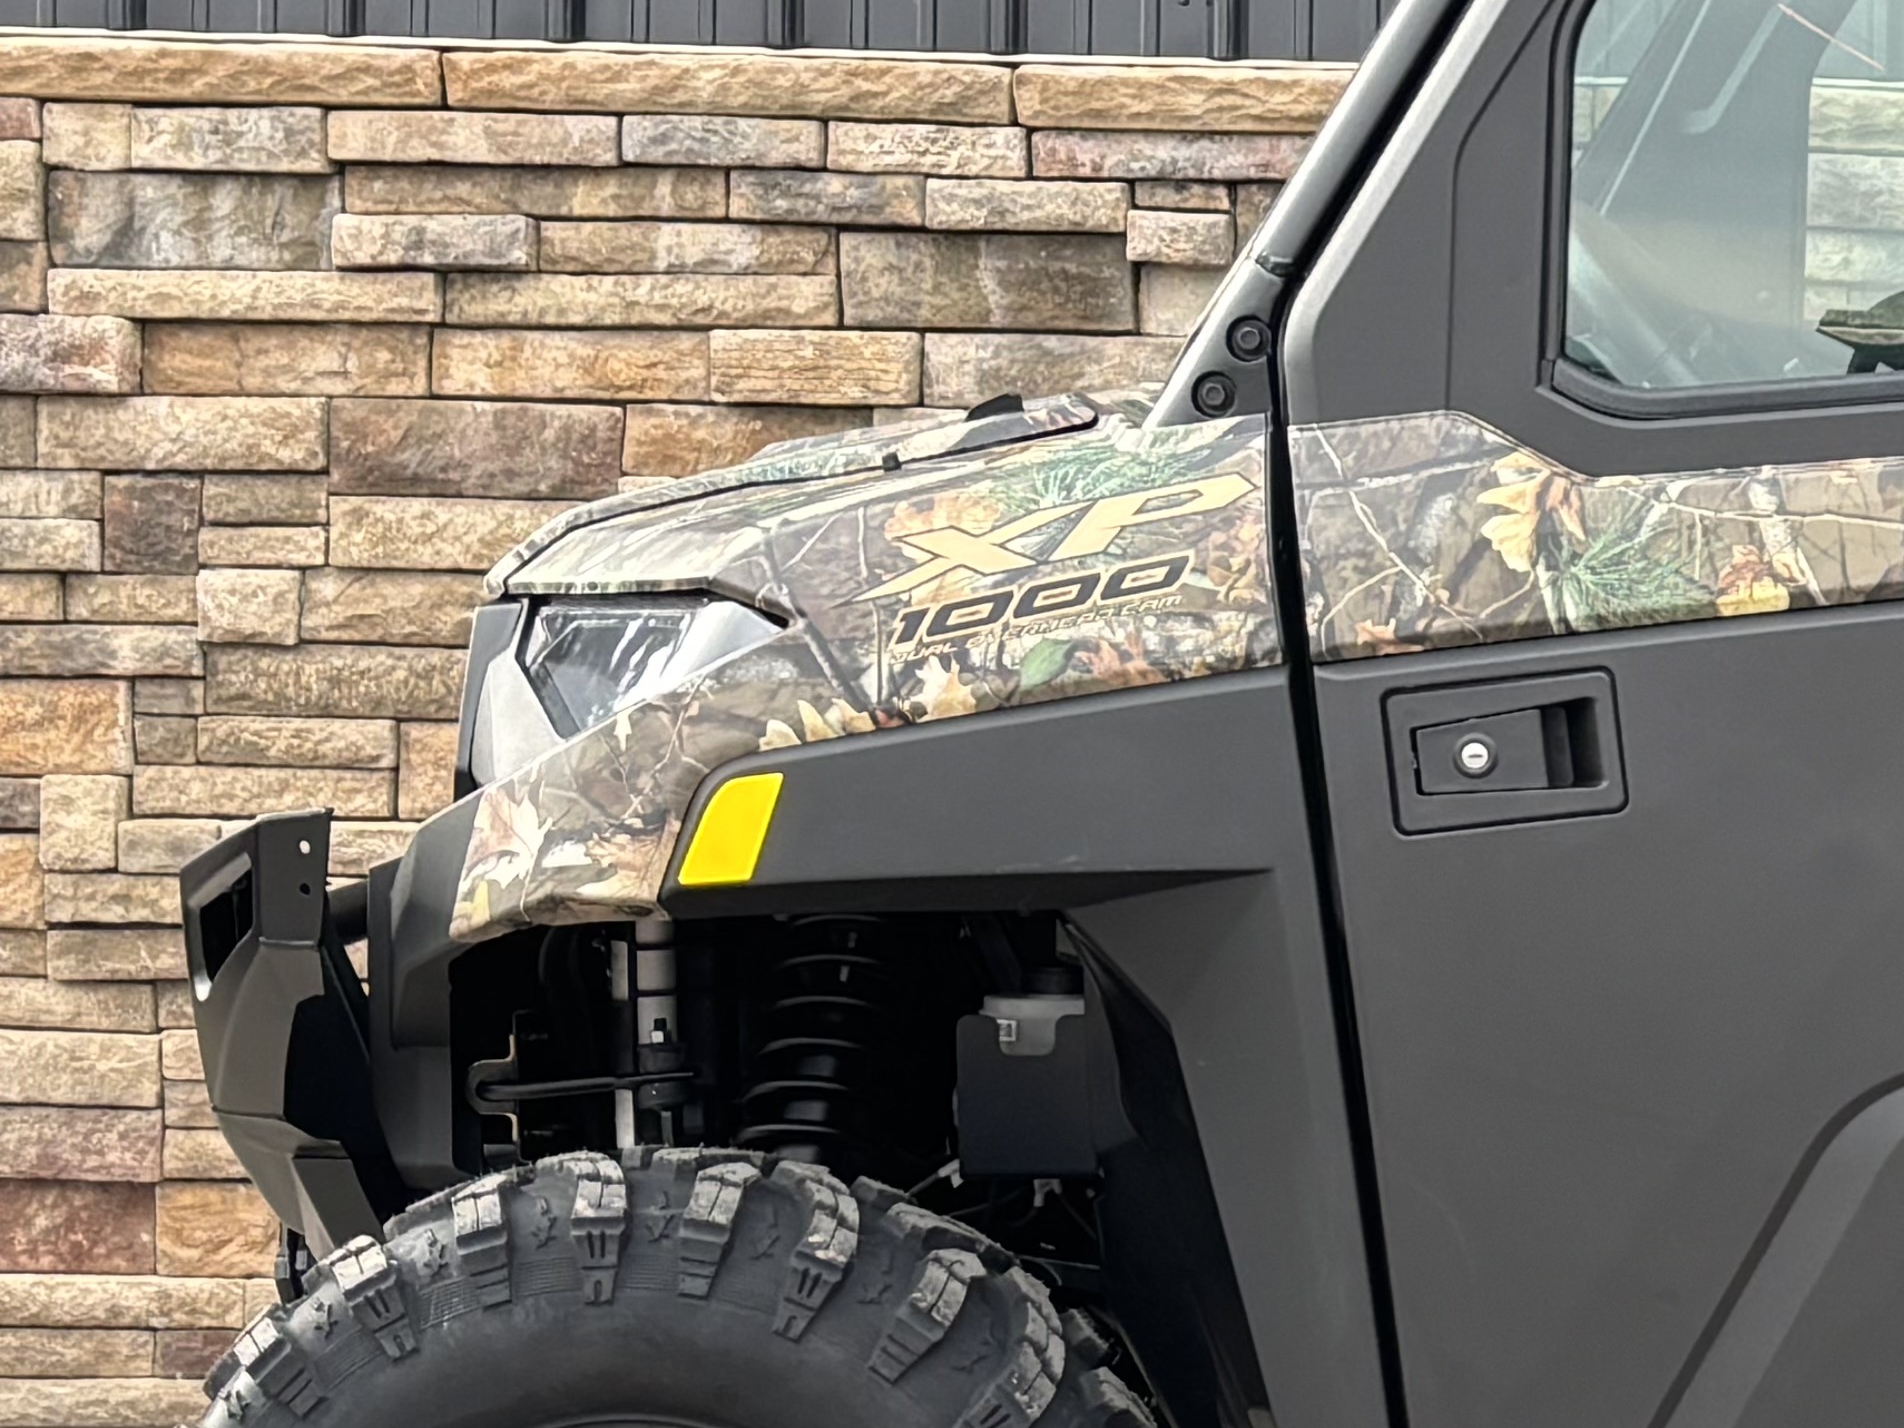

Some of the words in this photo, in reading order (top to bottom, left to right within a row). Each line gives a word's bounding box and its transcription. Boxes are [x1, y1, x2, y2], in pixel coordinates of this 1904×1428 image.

[833, 471, 1260, 608] XP
[885, 550, 1196, 653] 1000
[890, 642, 958, 665] DUAL
[1119, 594, 1183, 617] CAM
